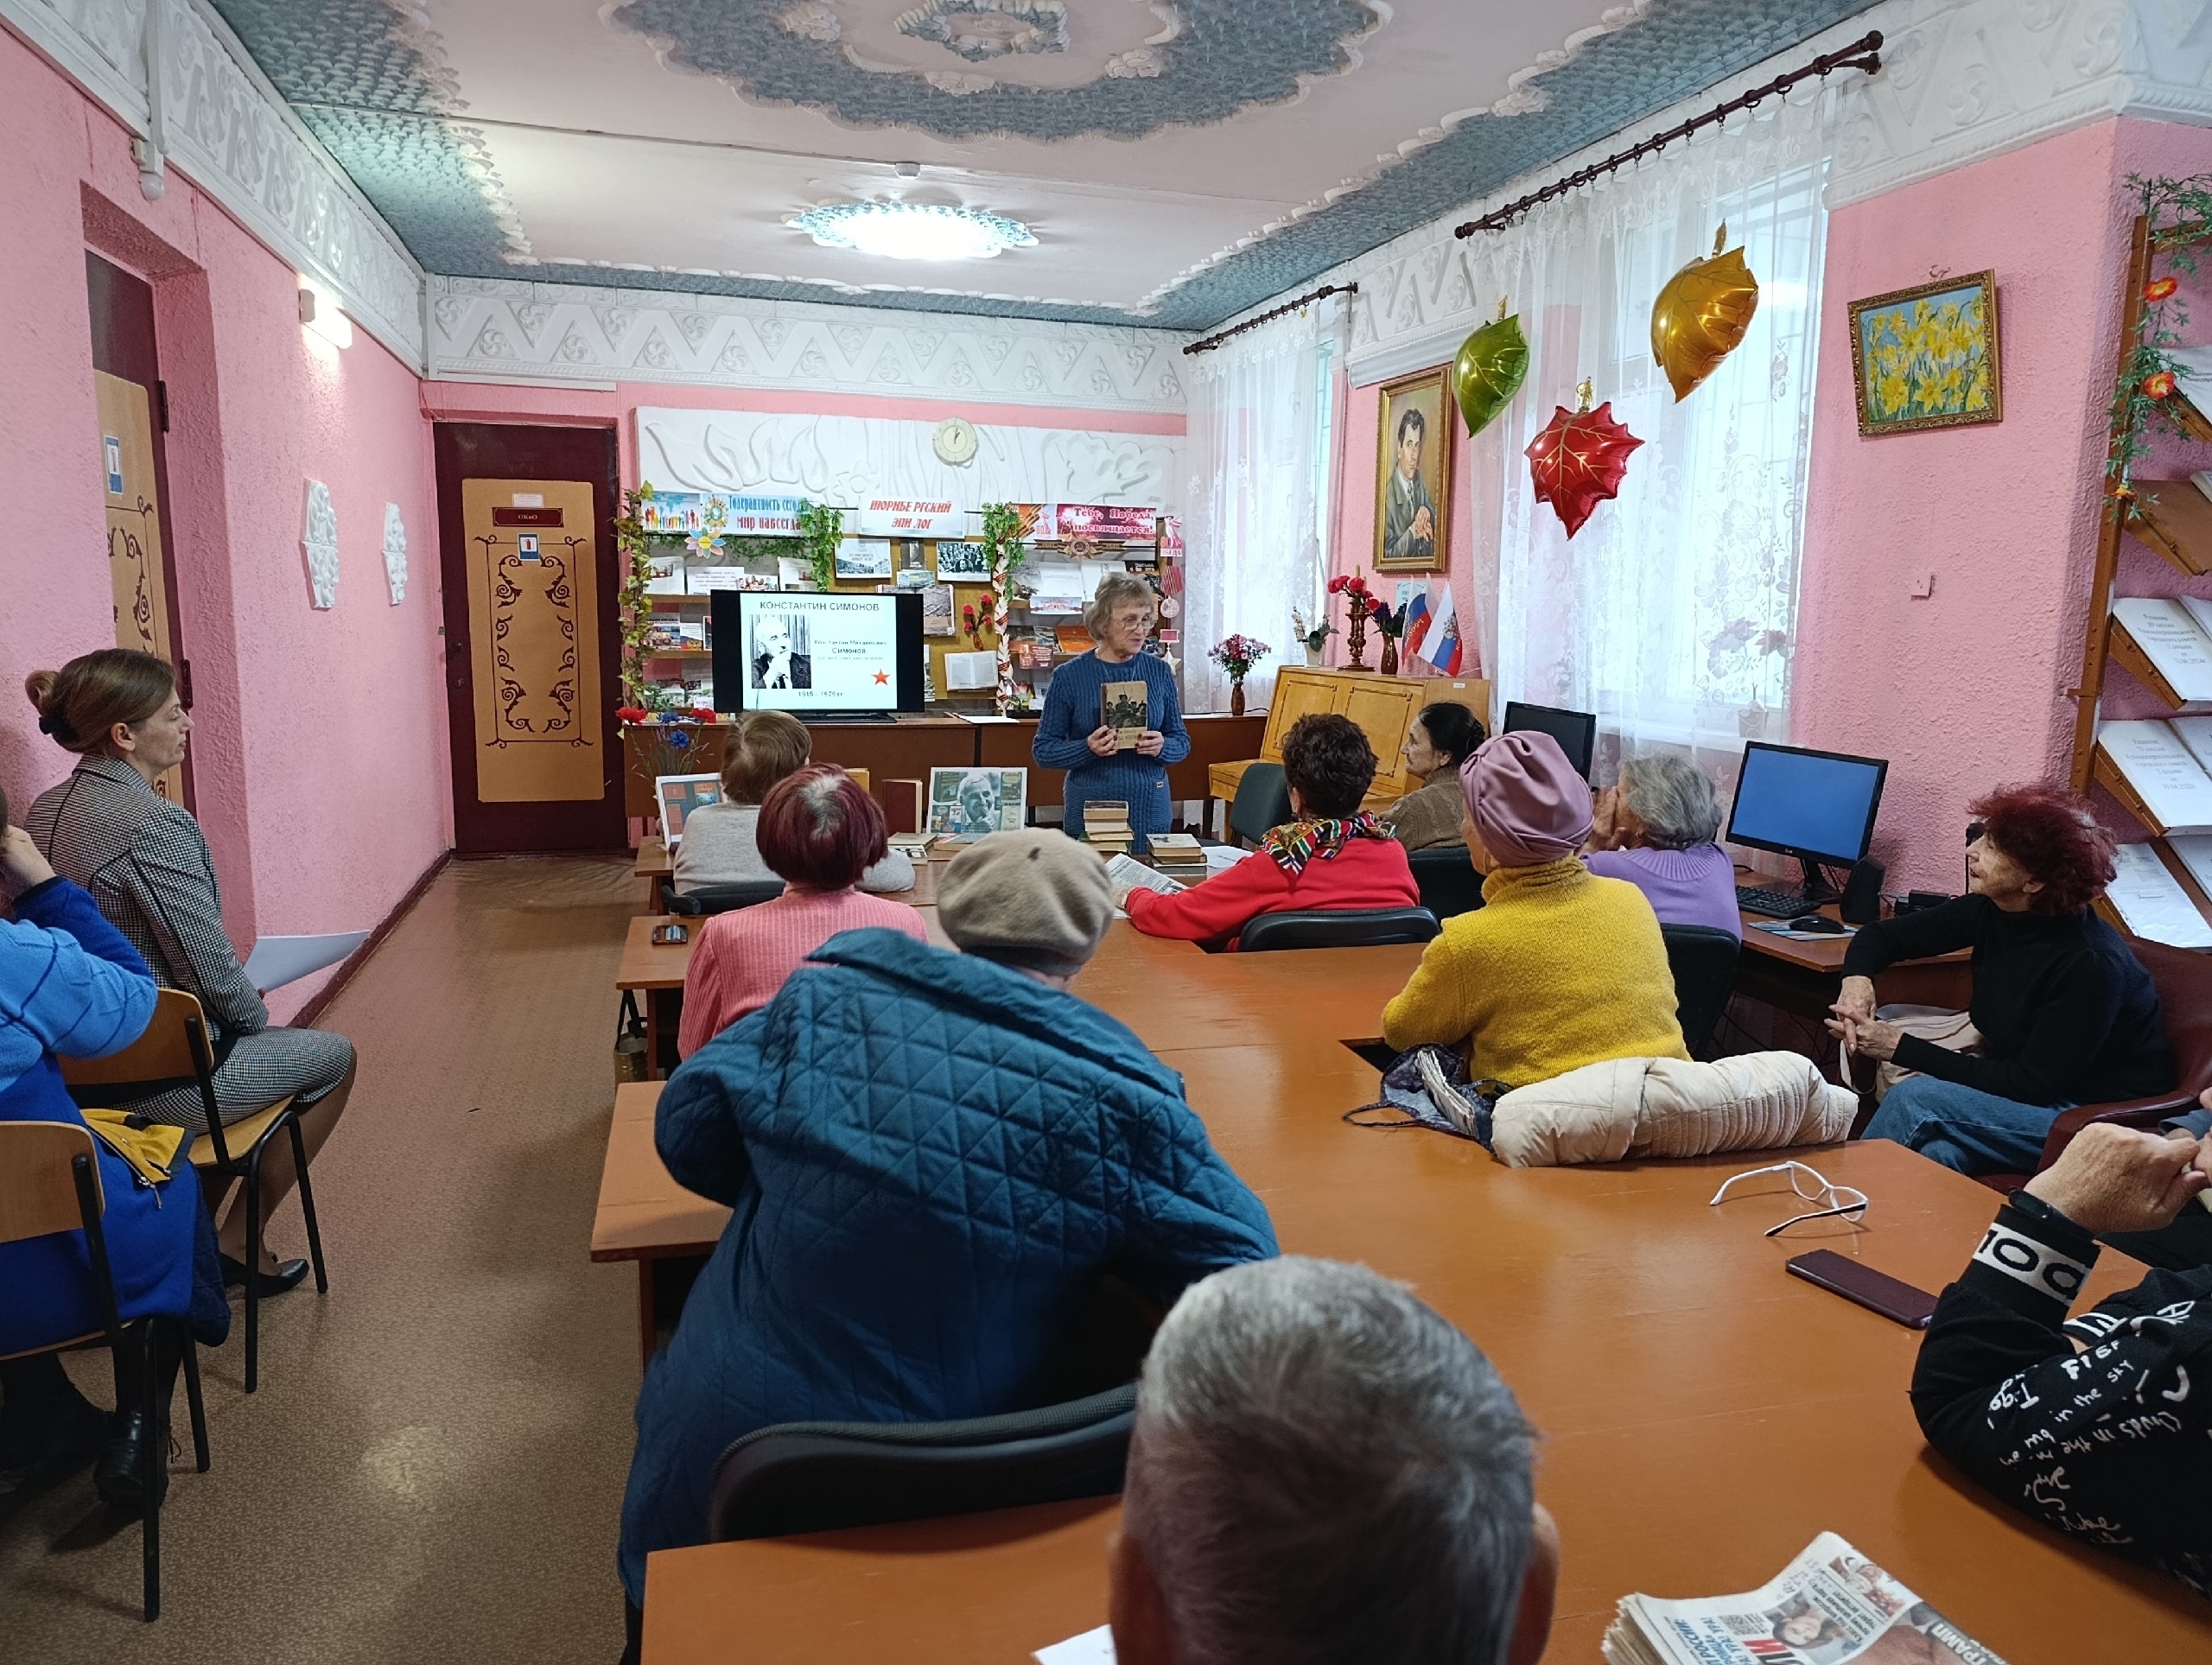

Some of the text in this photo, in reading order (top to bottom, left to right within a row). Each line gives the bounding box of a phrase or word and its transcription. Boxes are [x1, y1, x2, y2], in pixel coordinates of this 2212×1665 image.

[1074, 507, 1154, 521] Тебе, Победа,
[737, 516, 801, 531] мир навсегда
[1073, 524, 1154, 534] посвящается!
[760, 601, 880, 611] КОНСТАНТИН СИМОНОВ
[2073, 1388, 2102, 1407] the
[2060, 1436, 2092, 1453] the
